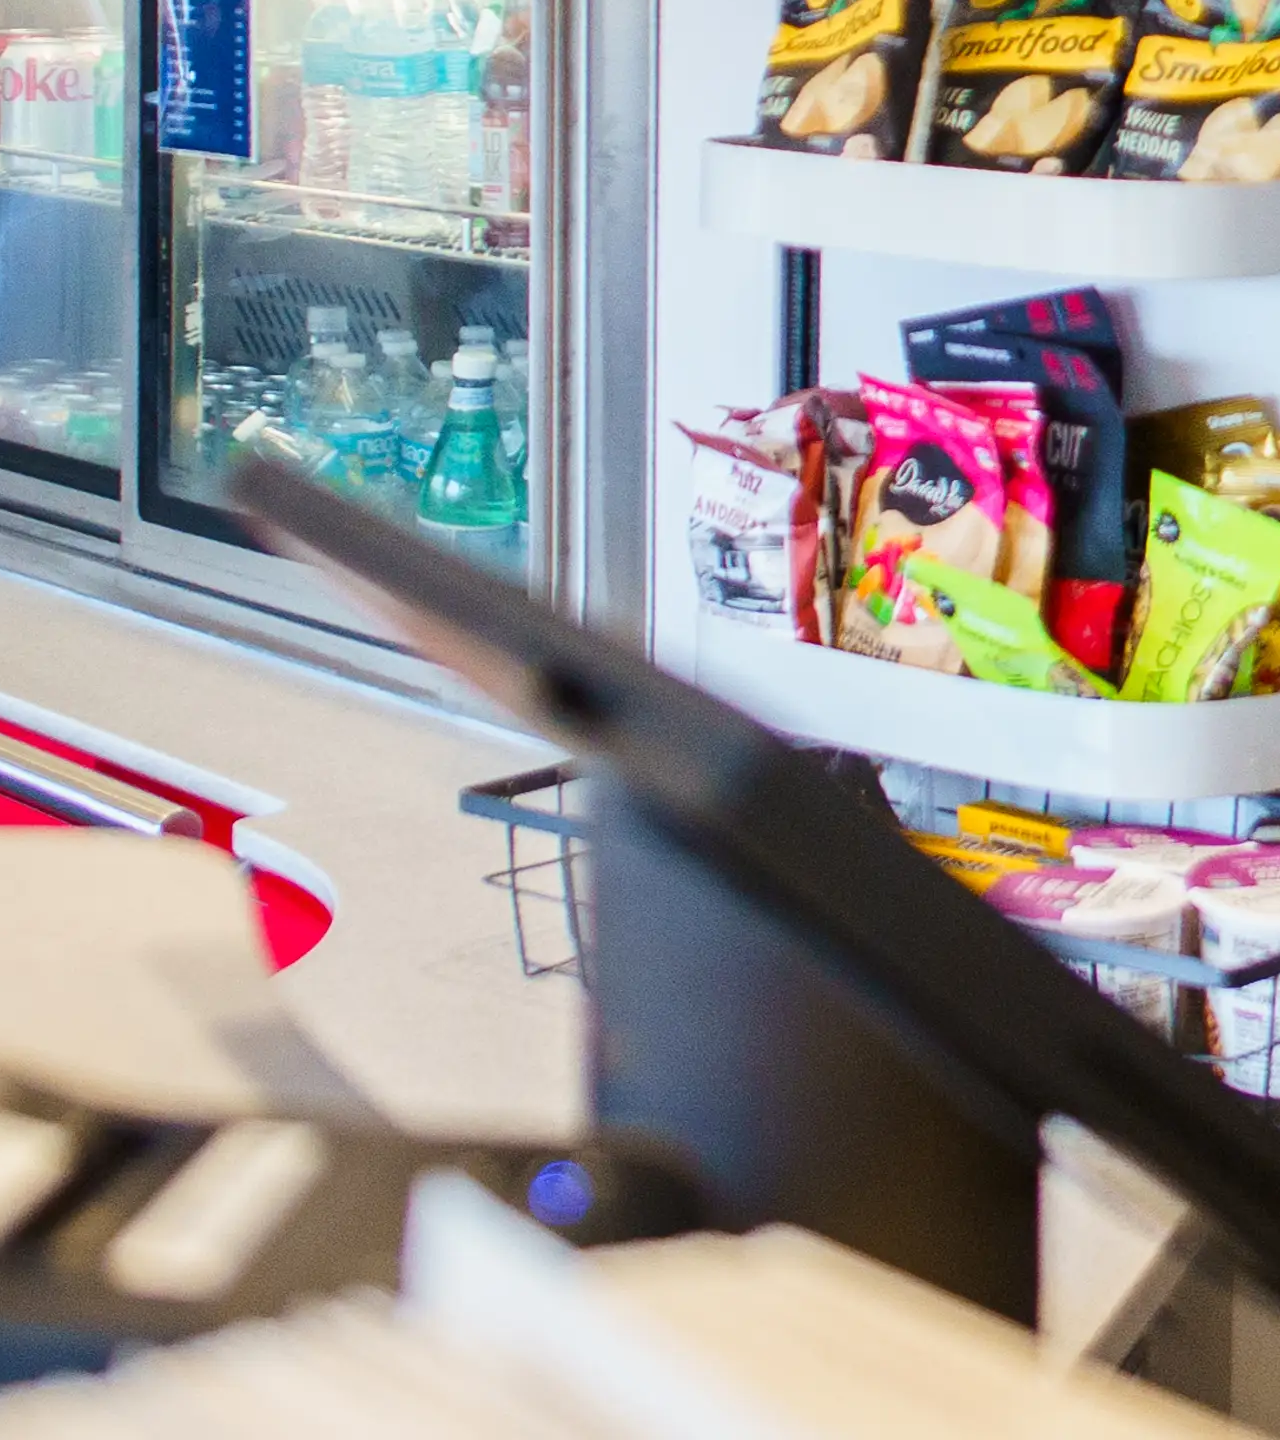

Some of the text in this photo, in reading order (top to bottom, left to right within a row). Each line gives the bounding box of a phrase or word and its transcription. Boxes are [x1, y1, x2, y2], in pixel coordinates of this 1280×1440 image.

[949, 23, 1108, 61] Smartfood
[1125, 105, 1183, 135] WHITE
[1114, 129, 1182, 163] HEDDAR
[1046, 420, 1088, 469] CUT
[1141, 581, 1212, 702] TACHIOS
